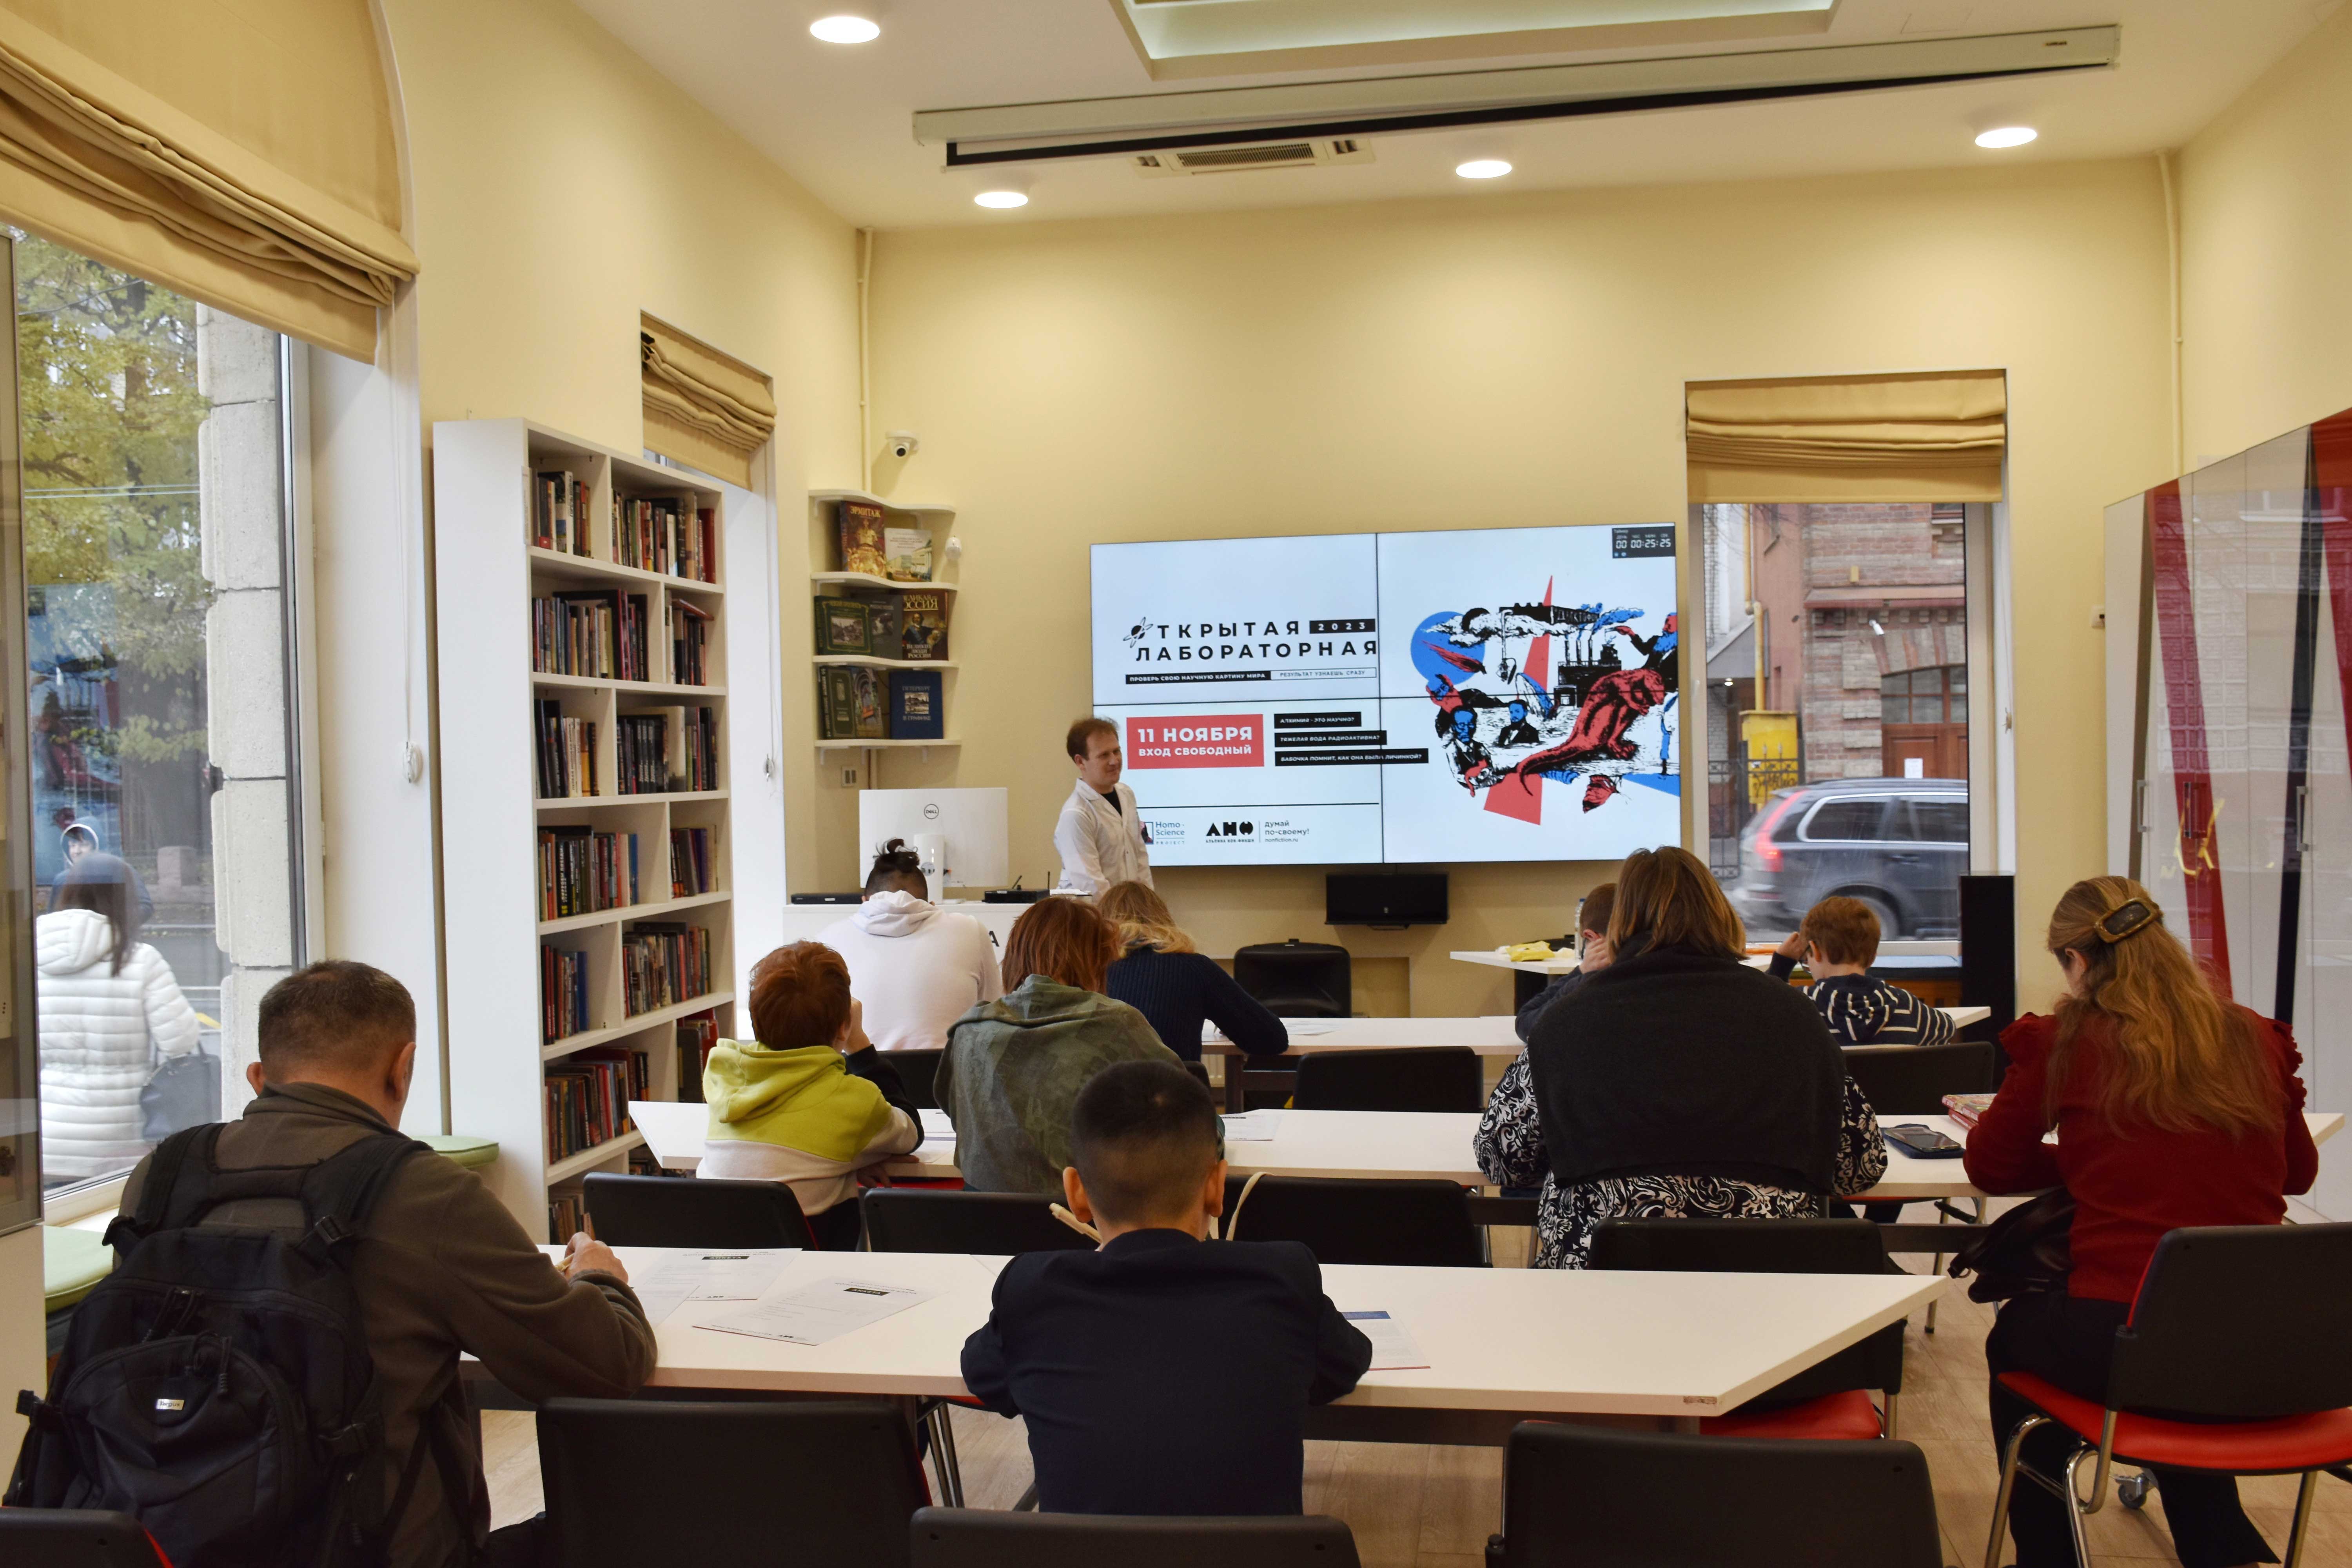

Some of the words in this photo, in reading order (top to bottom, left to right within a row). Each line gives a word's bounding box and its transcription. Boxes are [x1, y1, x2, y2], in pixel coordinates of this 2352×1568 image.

[850, 506, 881, 517] ЭРМИТАЖ
[1616, 540, 1627, 549] 00
[1318, 622, 1365, 631] 2023
[1136, 641, 1377, 661] ЛАБОРАТОРНАЯ
[1138, 728, 1154, 742] 11
[1163, 726, 1253, 742] НОЯБРЯ
[1139, 748, 1171, 757] ВХОД
[1174, 744, 1252, 756] СВОБОДНЫЙ
